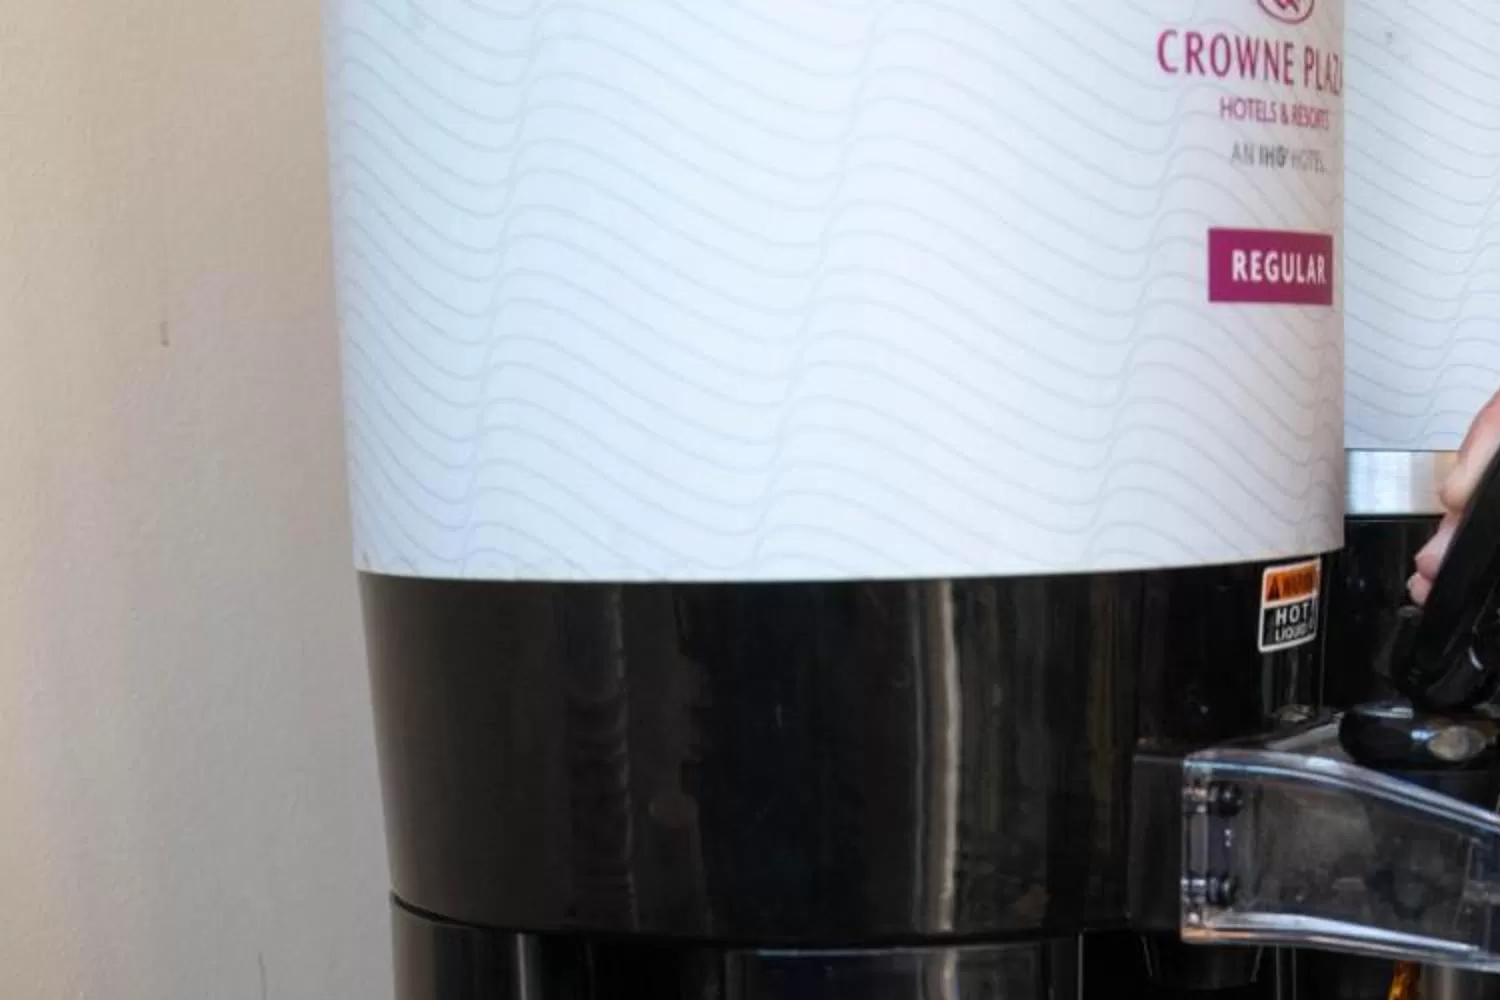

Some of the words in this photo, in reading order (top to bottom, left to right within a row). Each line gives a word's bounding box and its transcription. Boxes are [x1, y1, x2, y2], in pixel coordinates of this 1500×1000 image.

[1156, 29, 1295, 86] CROWNE
[1219, 96, 1277, 124] HOTELS
[1280, 102, 1289, 125] &
[1231, 249, 1326, 285] REGULAR
[1275, 603, 1310, 626] HOT
